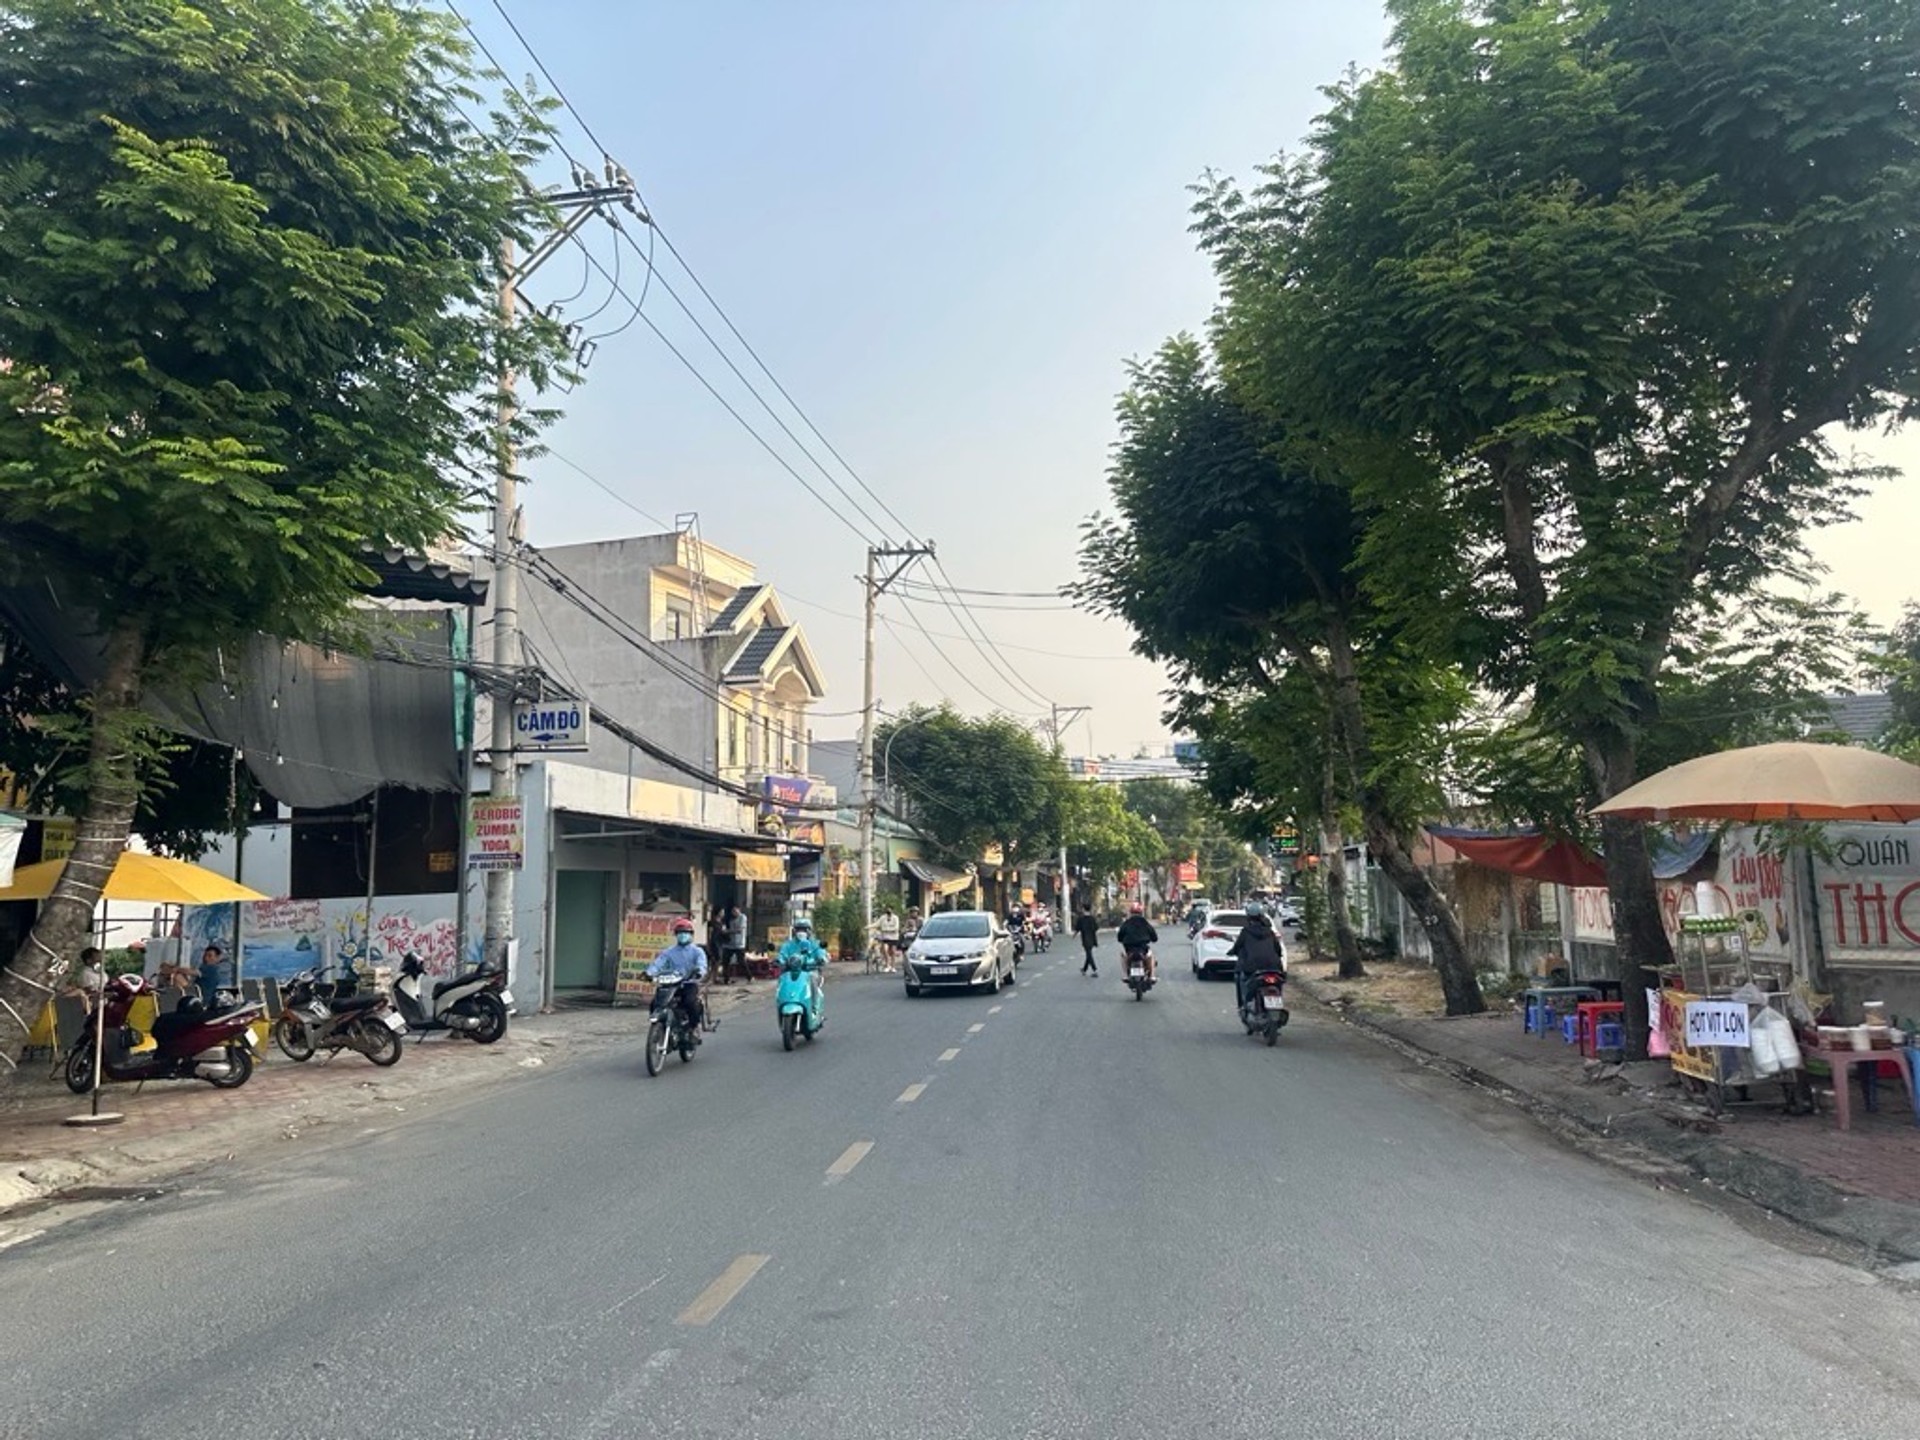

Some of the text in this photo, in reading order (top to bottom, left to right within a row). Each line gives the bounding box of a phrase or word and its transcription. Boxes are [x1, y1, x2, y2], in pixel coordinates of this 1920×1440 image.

[517, 702, 580, 731] CẦM ĐỒ
[472, 807, 521, 821] AEROBIC
[476, 823, 517, 837] ZUMBA
[481, 839, 511, 852] YOGA
[1838, 833, 1910, 866] QUÁN
